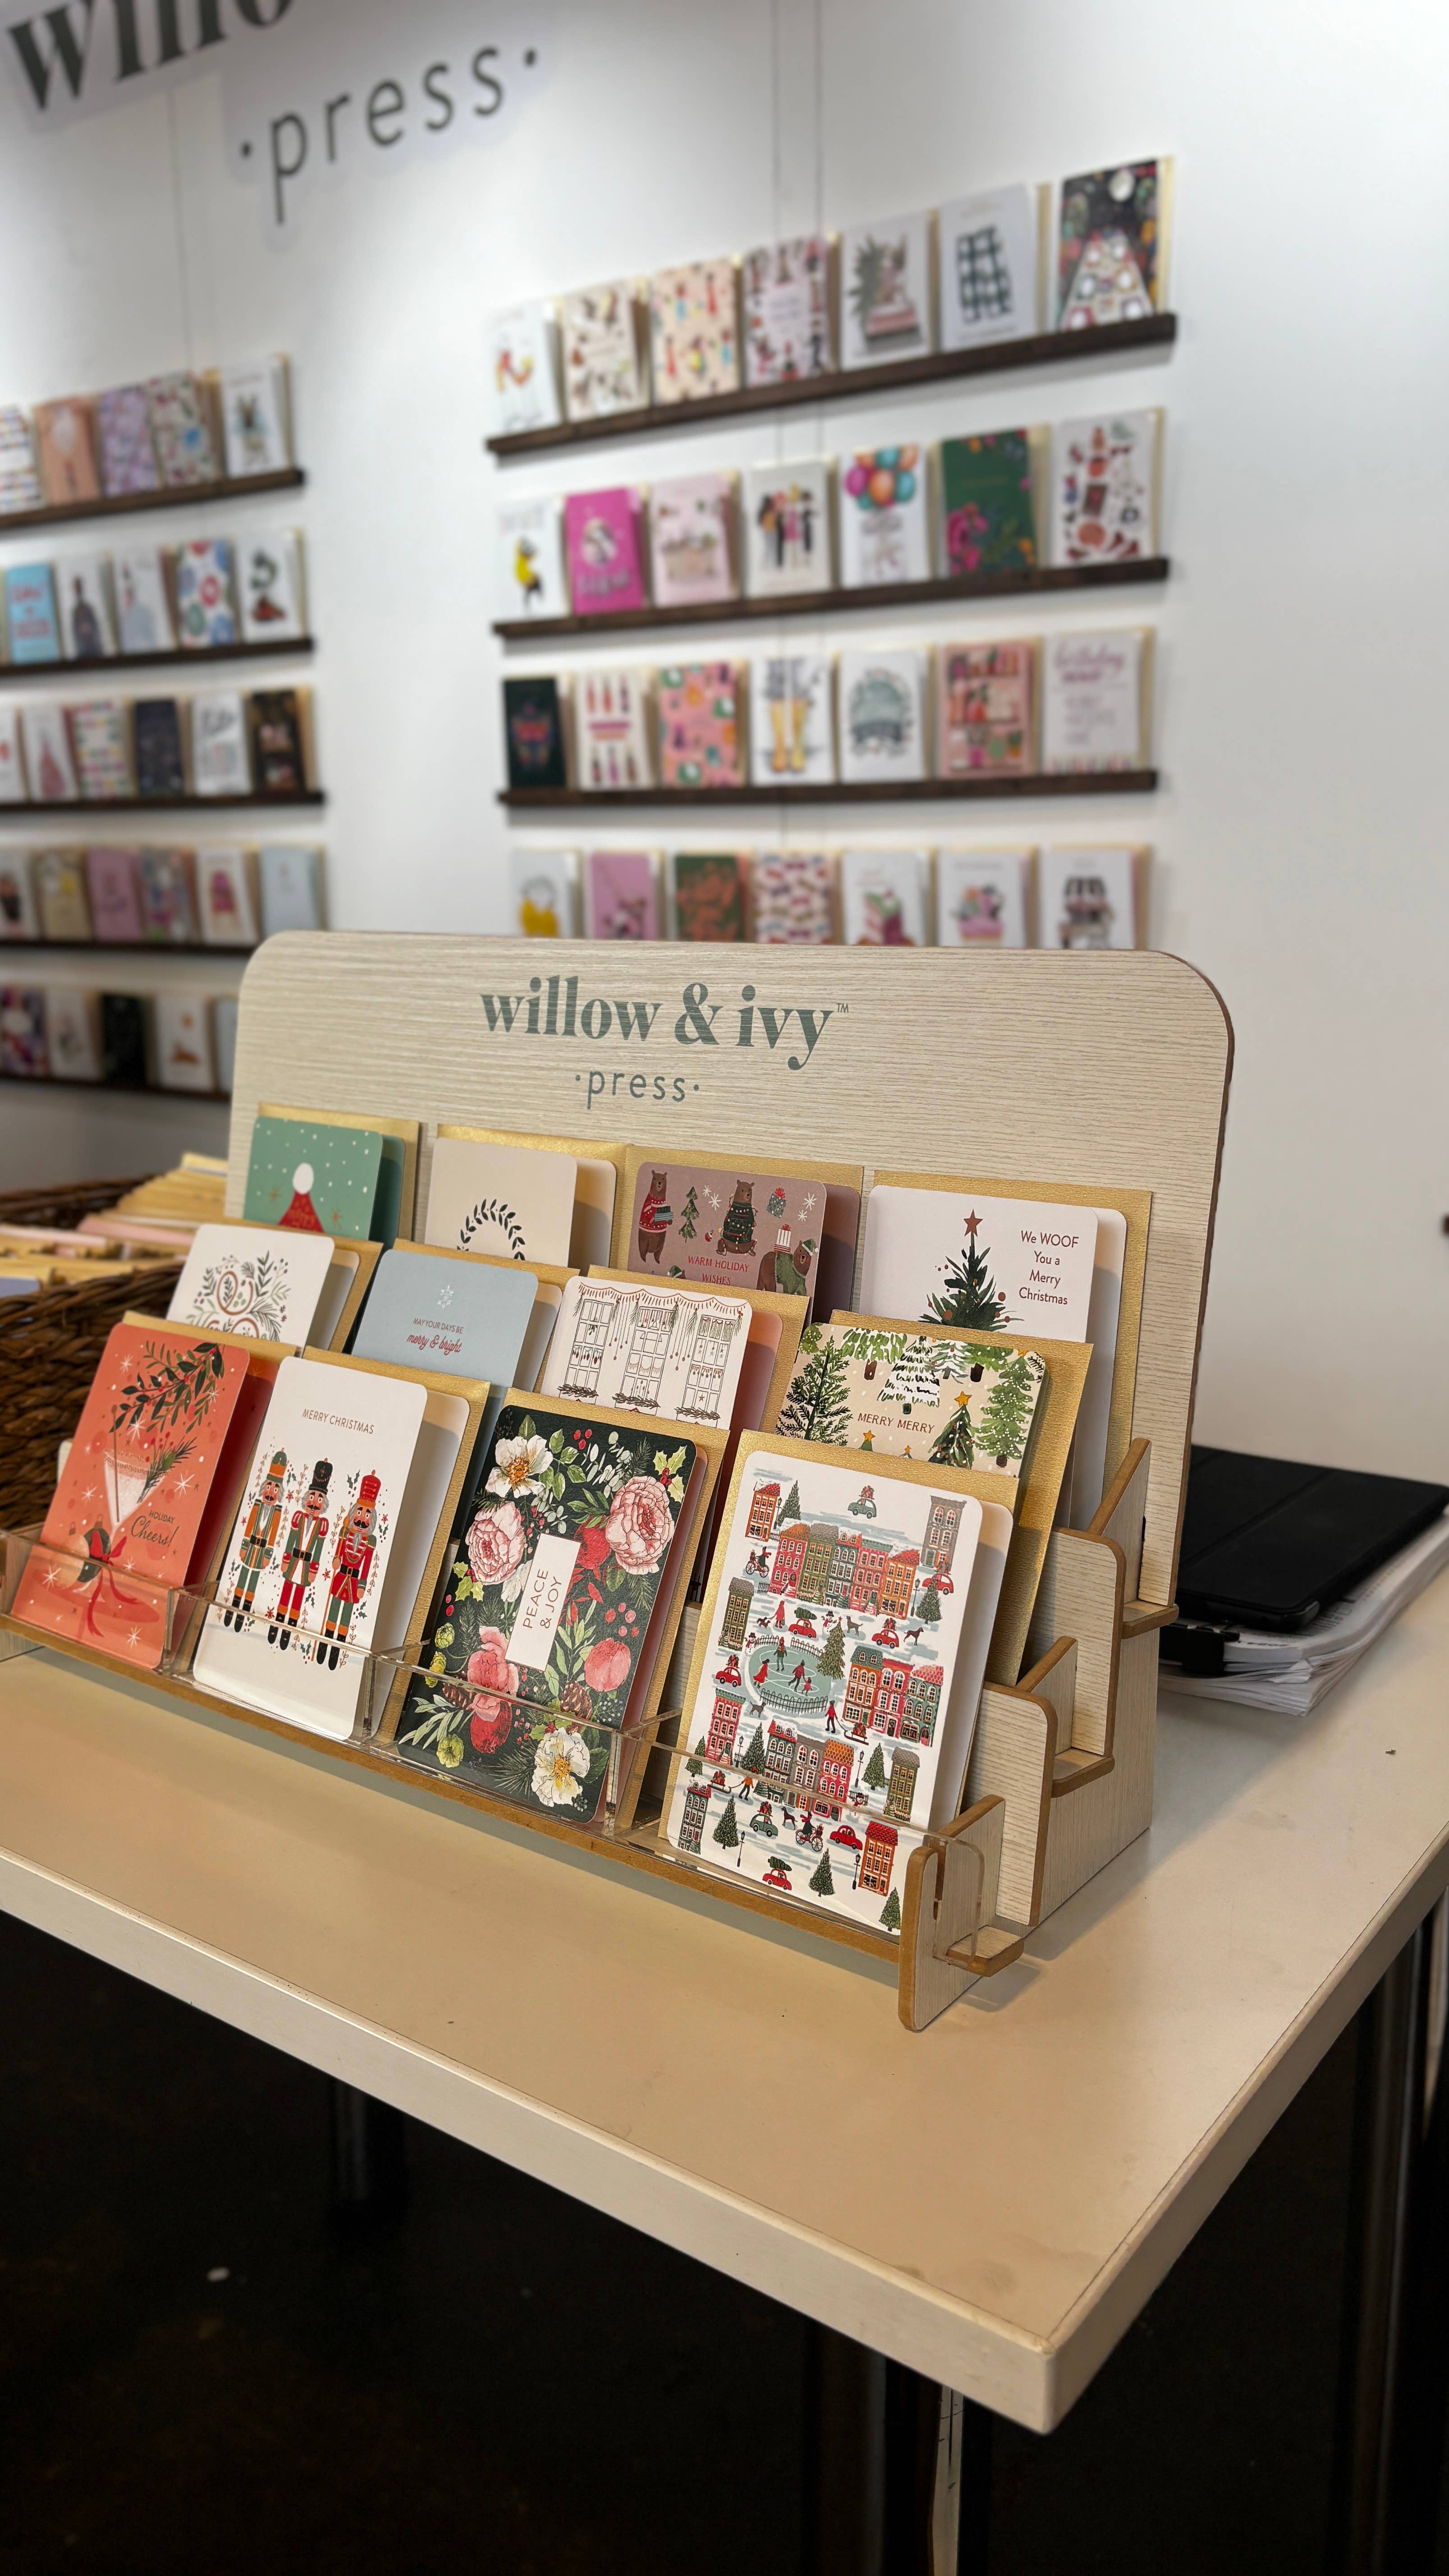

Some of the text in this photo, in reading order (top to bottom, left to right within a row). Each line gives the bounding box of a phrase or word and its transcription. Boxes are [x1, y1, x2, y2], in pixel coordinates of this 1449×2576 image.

[479, 975, 663, 1041] willow
[674, 982, 724, 1046] &
[1021, 1230, 1079, 1248] We WOOF
[688, 1255, 749, 1273] WARM HOLIDAY
[1034, 1250, 1052, 1265] You
[702, 1273, 731, 1285] WISHES
[1029, 1269, 1061, 1289] Merry
[1019, 1287, 1068, 1305] Christmas
[413, 1318, 426, 1326] MAY
[426, 1320, 440, 1329] YOUR
[441, 1323, 456, 1332] DAYS
[407, 1334, 462, 1356] merry & bright
[303, 1408, 375, 1435] MERRY CHRISTMAS
[857, 1412, 935, 1434] MERRY MERRY
[149, 1509, 175, 1524] HOLIDAY
[131, 1515, 179, 1547] Cheers!
[523, 1569, 549, 1629] PEACE
[540, 1576, 562, 1629] & JOY
